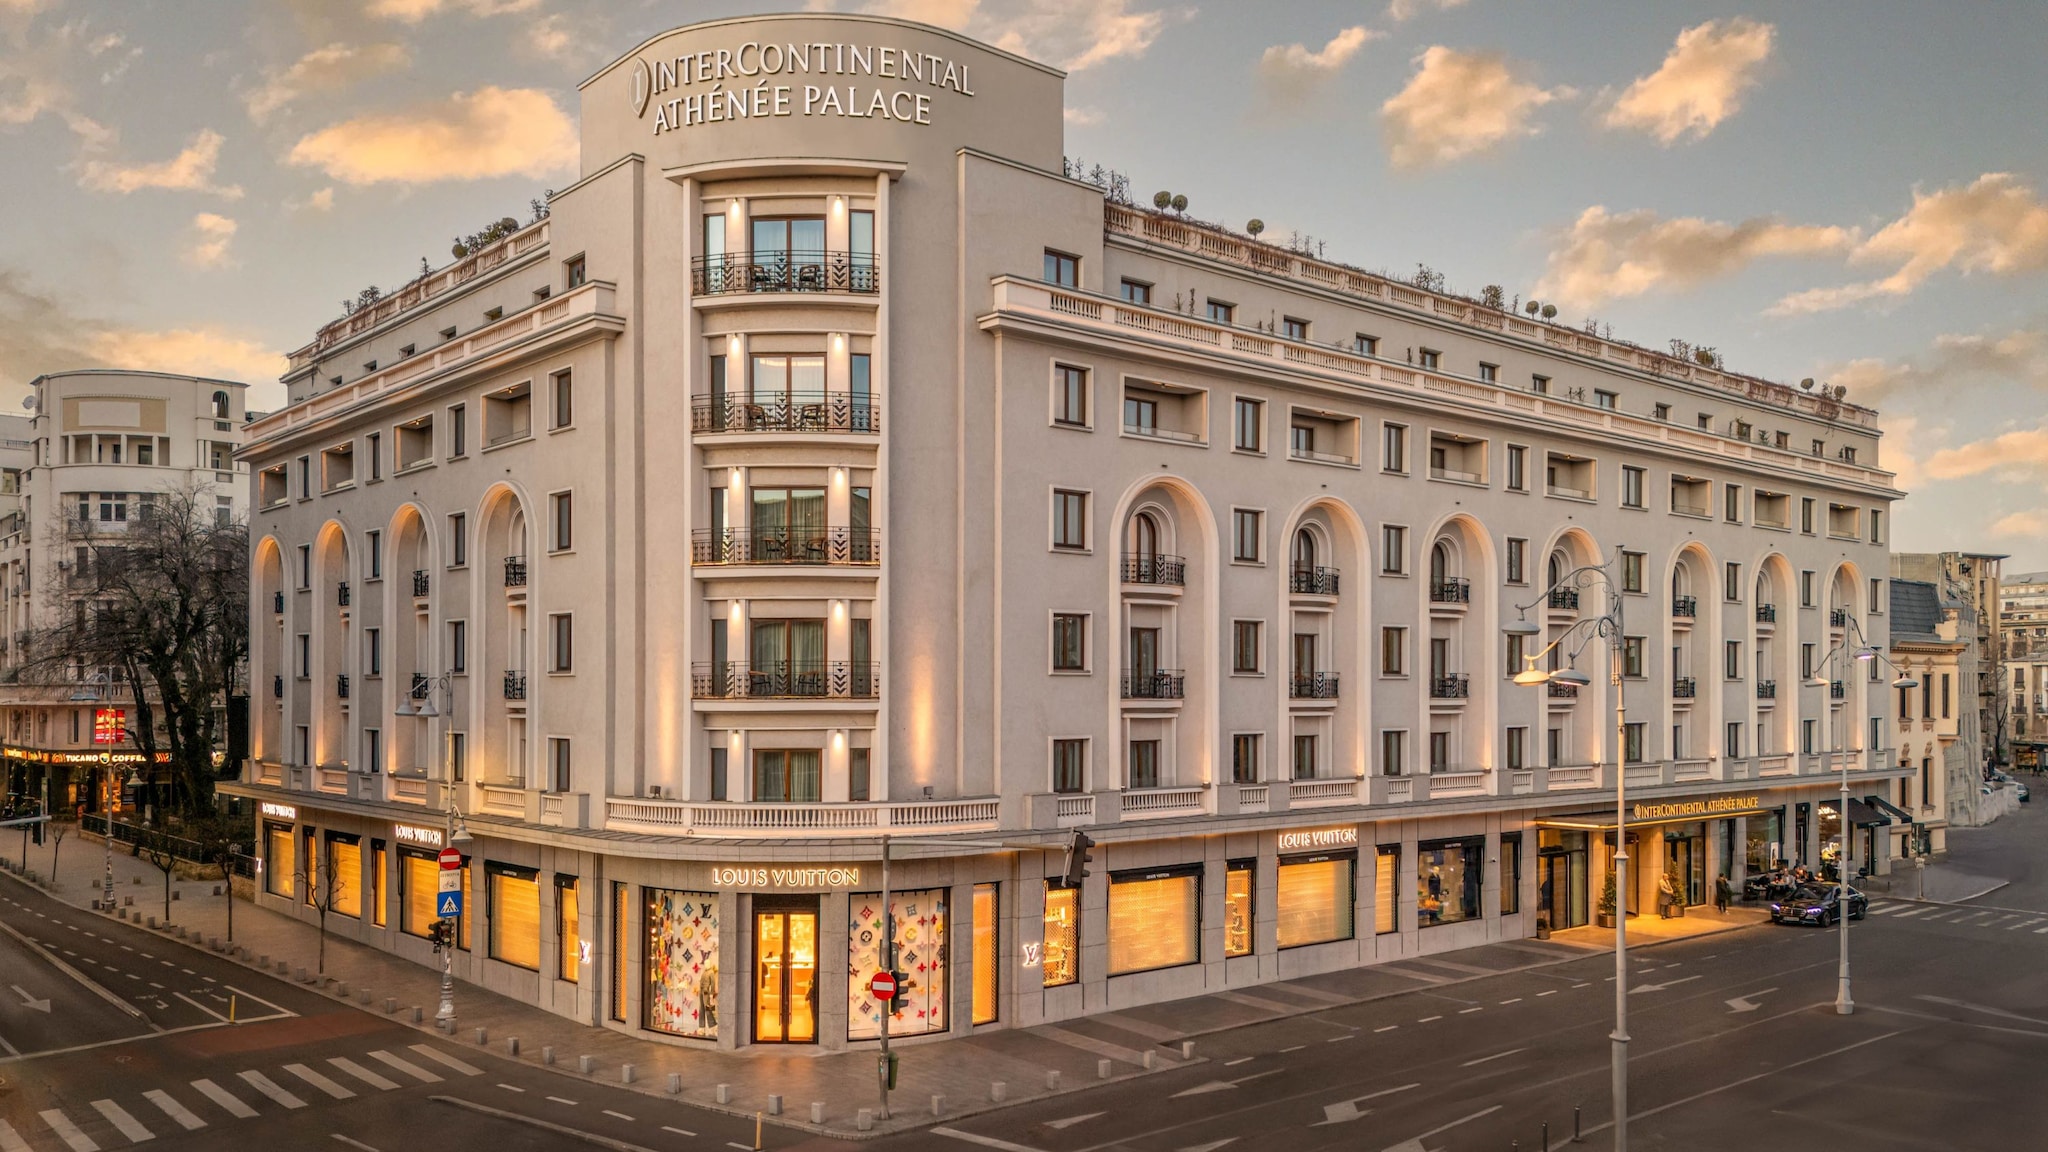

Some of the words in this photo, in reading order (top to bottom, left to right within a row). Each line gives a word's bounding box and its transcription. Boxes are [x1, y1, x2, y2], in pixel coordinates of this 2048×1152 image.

[652, 42, 975, 96] INTERCONTINENTAL
[653, 79, 792, 135] ATHÉNÉE
[803, 85, 931, 125] PALACE
[66, 754, 98, 762] TUCANO
[1736, 796, 1759, 809] PALACE
[395, 824, 414, 841] LOUIS
[1279, 833, 1311, 849] LOUIS
[1312, 828, 1358, 846] VUITTON
[712, 868, 767, 887] LOUIS
[772, 868, 859, 886] VUITTON
